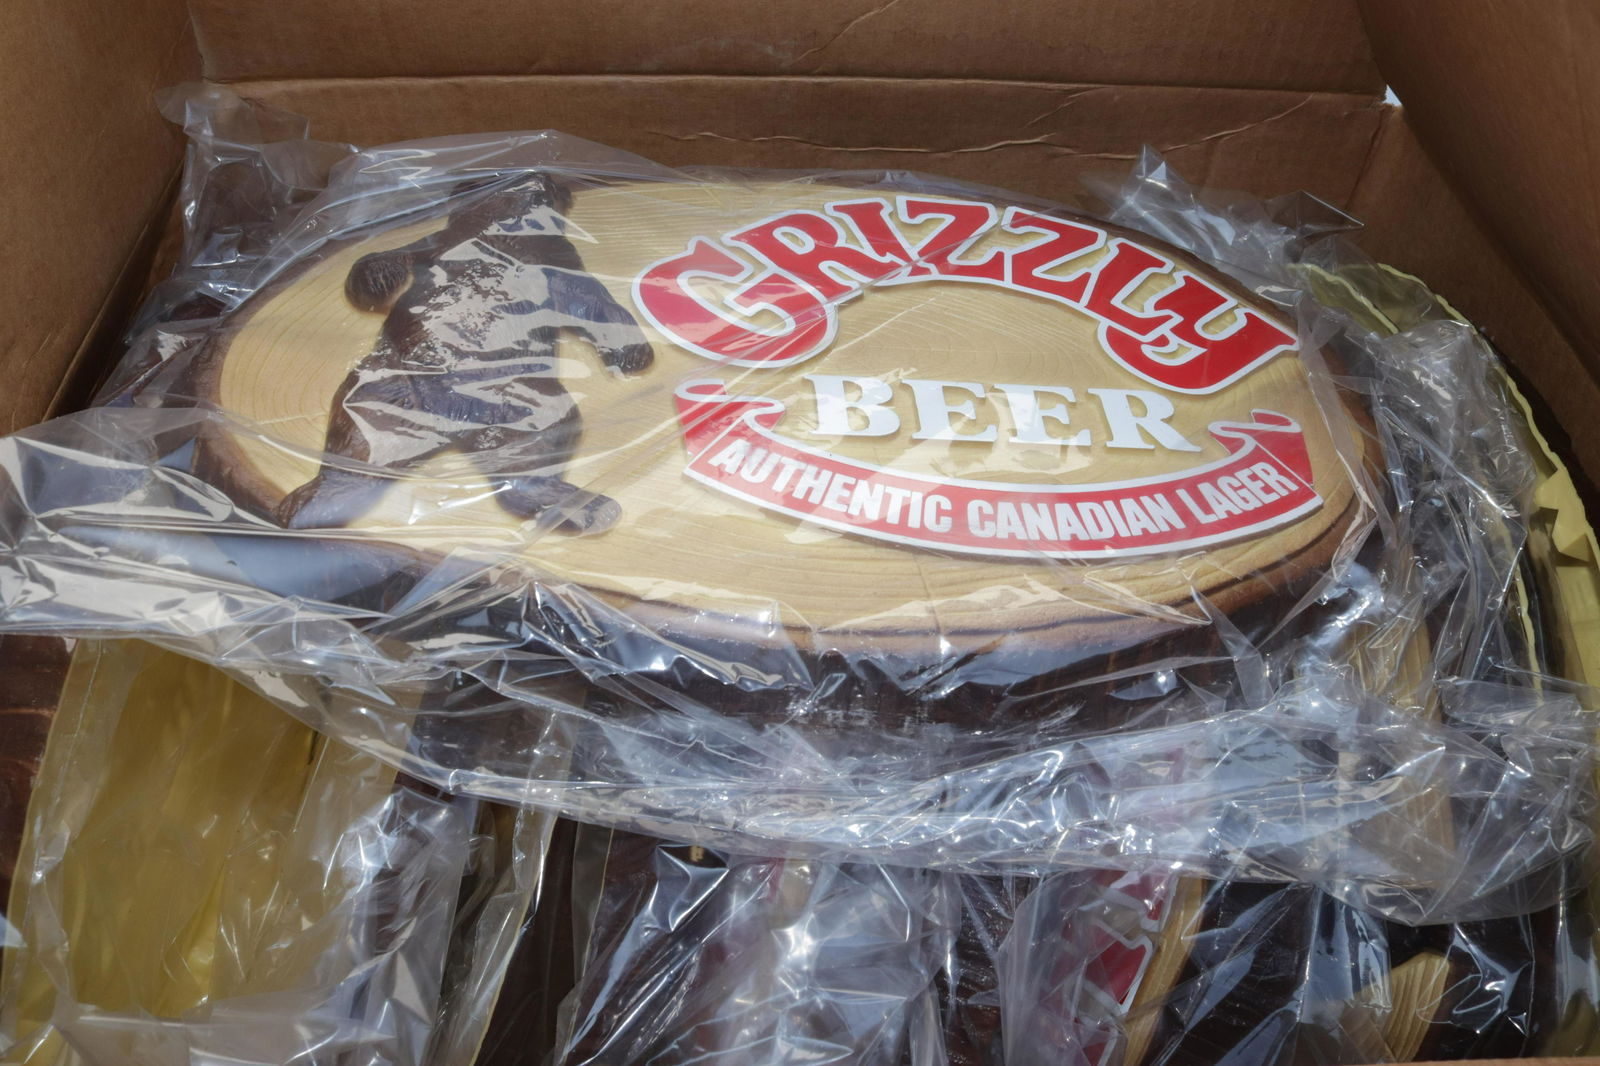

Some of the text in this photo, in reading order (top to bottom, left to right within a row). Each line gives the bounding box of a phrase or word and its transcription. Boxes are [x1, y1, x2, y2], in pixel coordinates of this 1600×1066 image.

[631, 194, 1299, 394] GRIZZLY
[803, 374, 1201, 452] BEER
[708, 440, 1298, 541] AUTHENTIC CANADIAN LAGER
